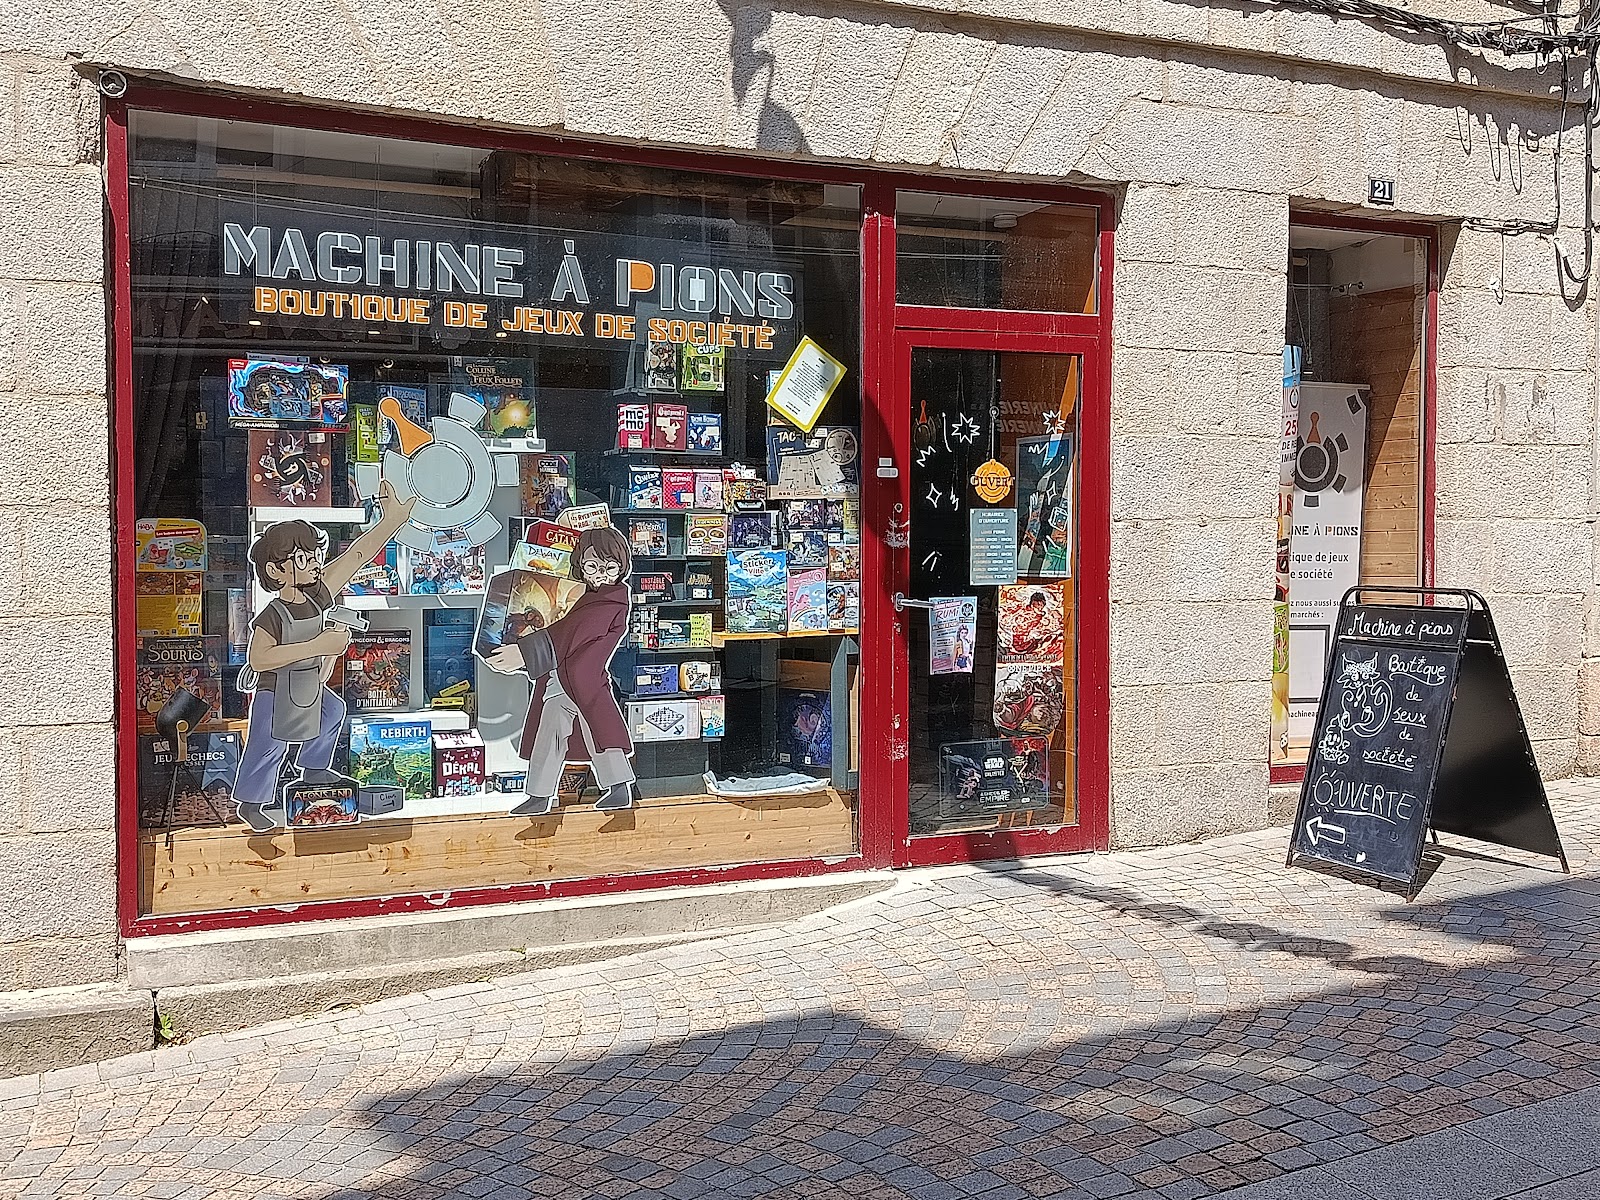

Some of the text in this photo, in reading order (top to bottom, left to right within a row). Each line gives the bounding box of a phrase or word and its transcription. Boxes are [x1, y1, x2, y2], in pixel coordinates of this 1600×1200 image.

[1374, 181, 1390, 198] 21
[224, 223, 795, 319] MACHINE À PIONS
[254, 286, 430, 325] BOUTIQUE
[443, 301, 488, 329] DE
[501, 306, 584, 337] JEUX
[594, 313, 636, 340] DE
[648, 316, 776, 350] SOCIÉTÉ
[697, 345, 721, 354] CUPS
[465, 365, 496, 374] COLLINE
[473, 375, 523, 385] FEUX FOLLETS
[634, 472, 660, 484] Qwixx
[970, 475, 1015, 486] OUVERT
[1313, 523, 1320, 535] À
[1325, 526, 1358, 536] PIONS
[545, 531, 578, 547] CATAN
[743, 559, 772, 568] Sticker
[1315, 552, 1327, 562] de
[1328, 552, 1349, 564] jeux
[747, 567, 765, 575] Ville
[1298, 569, 1333, 579] société
[641, 576, 665, 584] UNSTABLE
[1291, 610, 1320, 618] marchés
[1348, 611, 1454, 640] Machine à pions
[148, 645, 203, 662] SOURIS
[1008, 665, 1051, 673] ONE PIECE
[1388, 654, 1447, 684] Boutique
[1406, 685, 1423, 701] de
[356, 698, 397, 707] D'INITIATION
[380, 726, 427, 739] REBIRTH
[1399, 726, 1414, 740] de
[154, 754, 172, 765] JEU
[1362, 747, 1418, 768] société
[442, 761, 480, 776] DÉKAL
[984, 761, 1004, 769] WARS
[505, 779, 516, 789] JEU
[331, 788, 352, 799] END
[980, 795, 1010, 803] EMPIRE
[1313, 773, 1417, 820] OUVERTE
